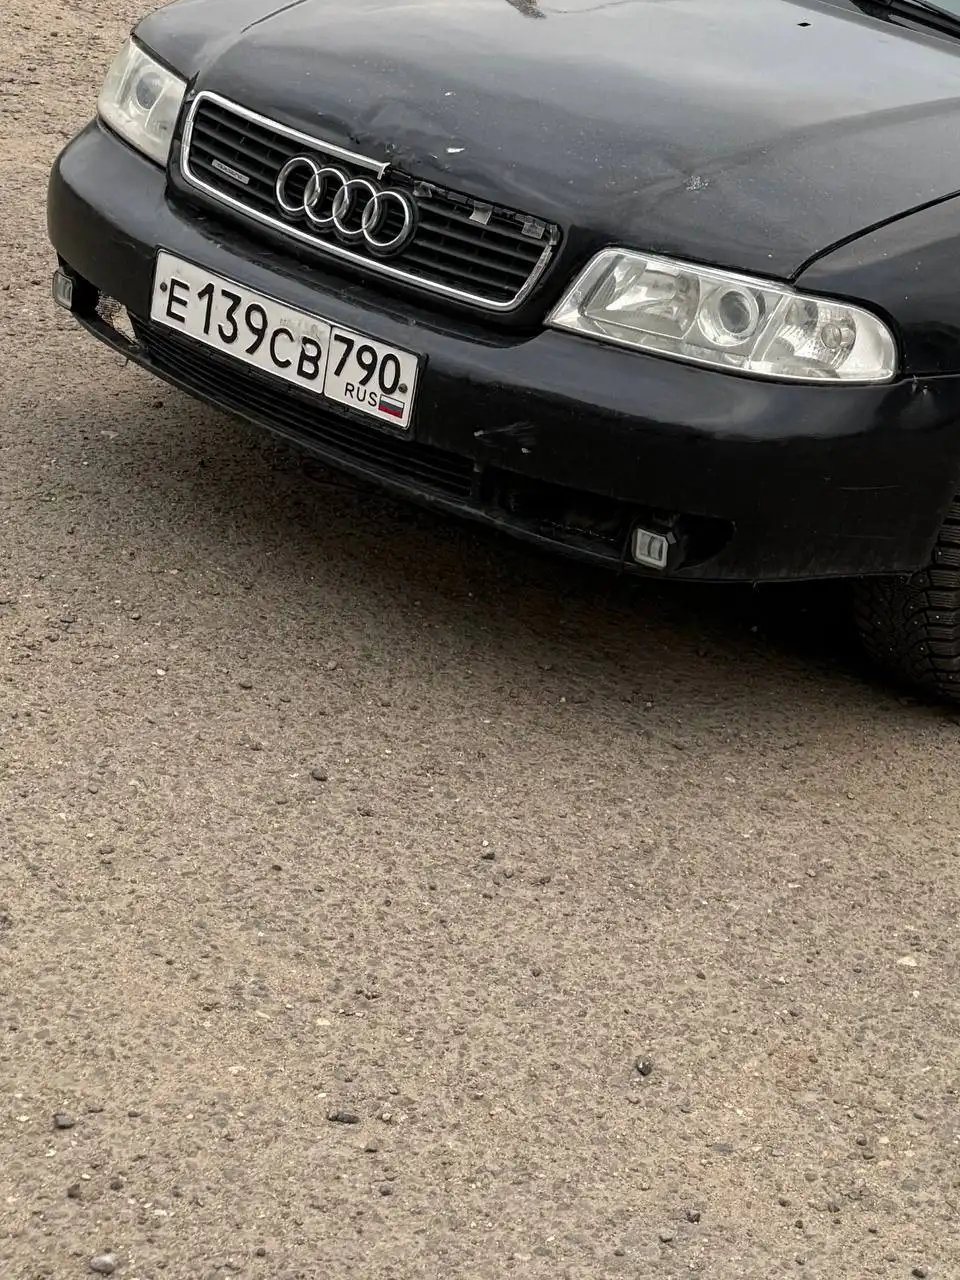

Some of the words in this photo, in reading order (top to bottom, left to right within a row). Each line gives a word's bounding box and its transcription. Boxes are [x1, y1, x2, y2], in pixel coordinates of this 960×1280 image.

[166, 278, 322, 380] Е139СВ
[333, 334, 402, 395] 790
[344, 382, 378, 408] RUS
